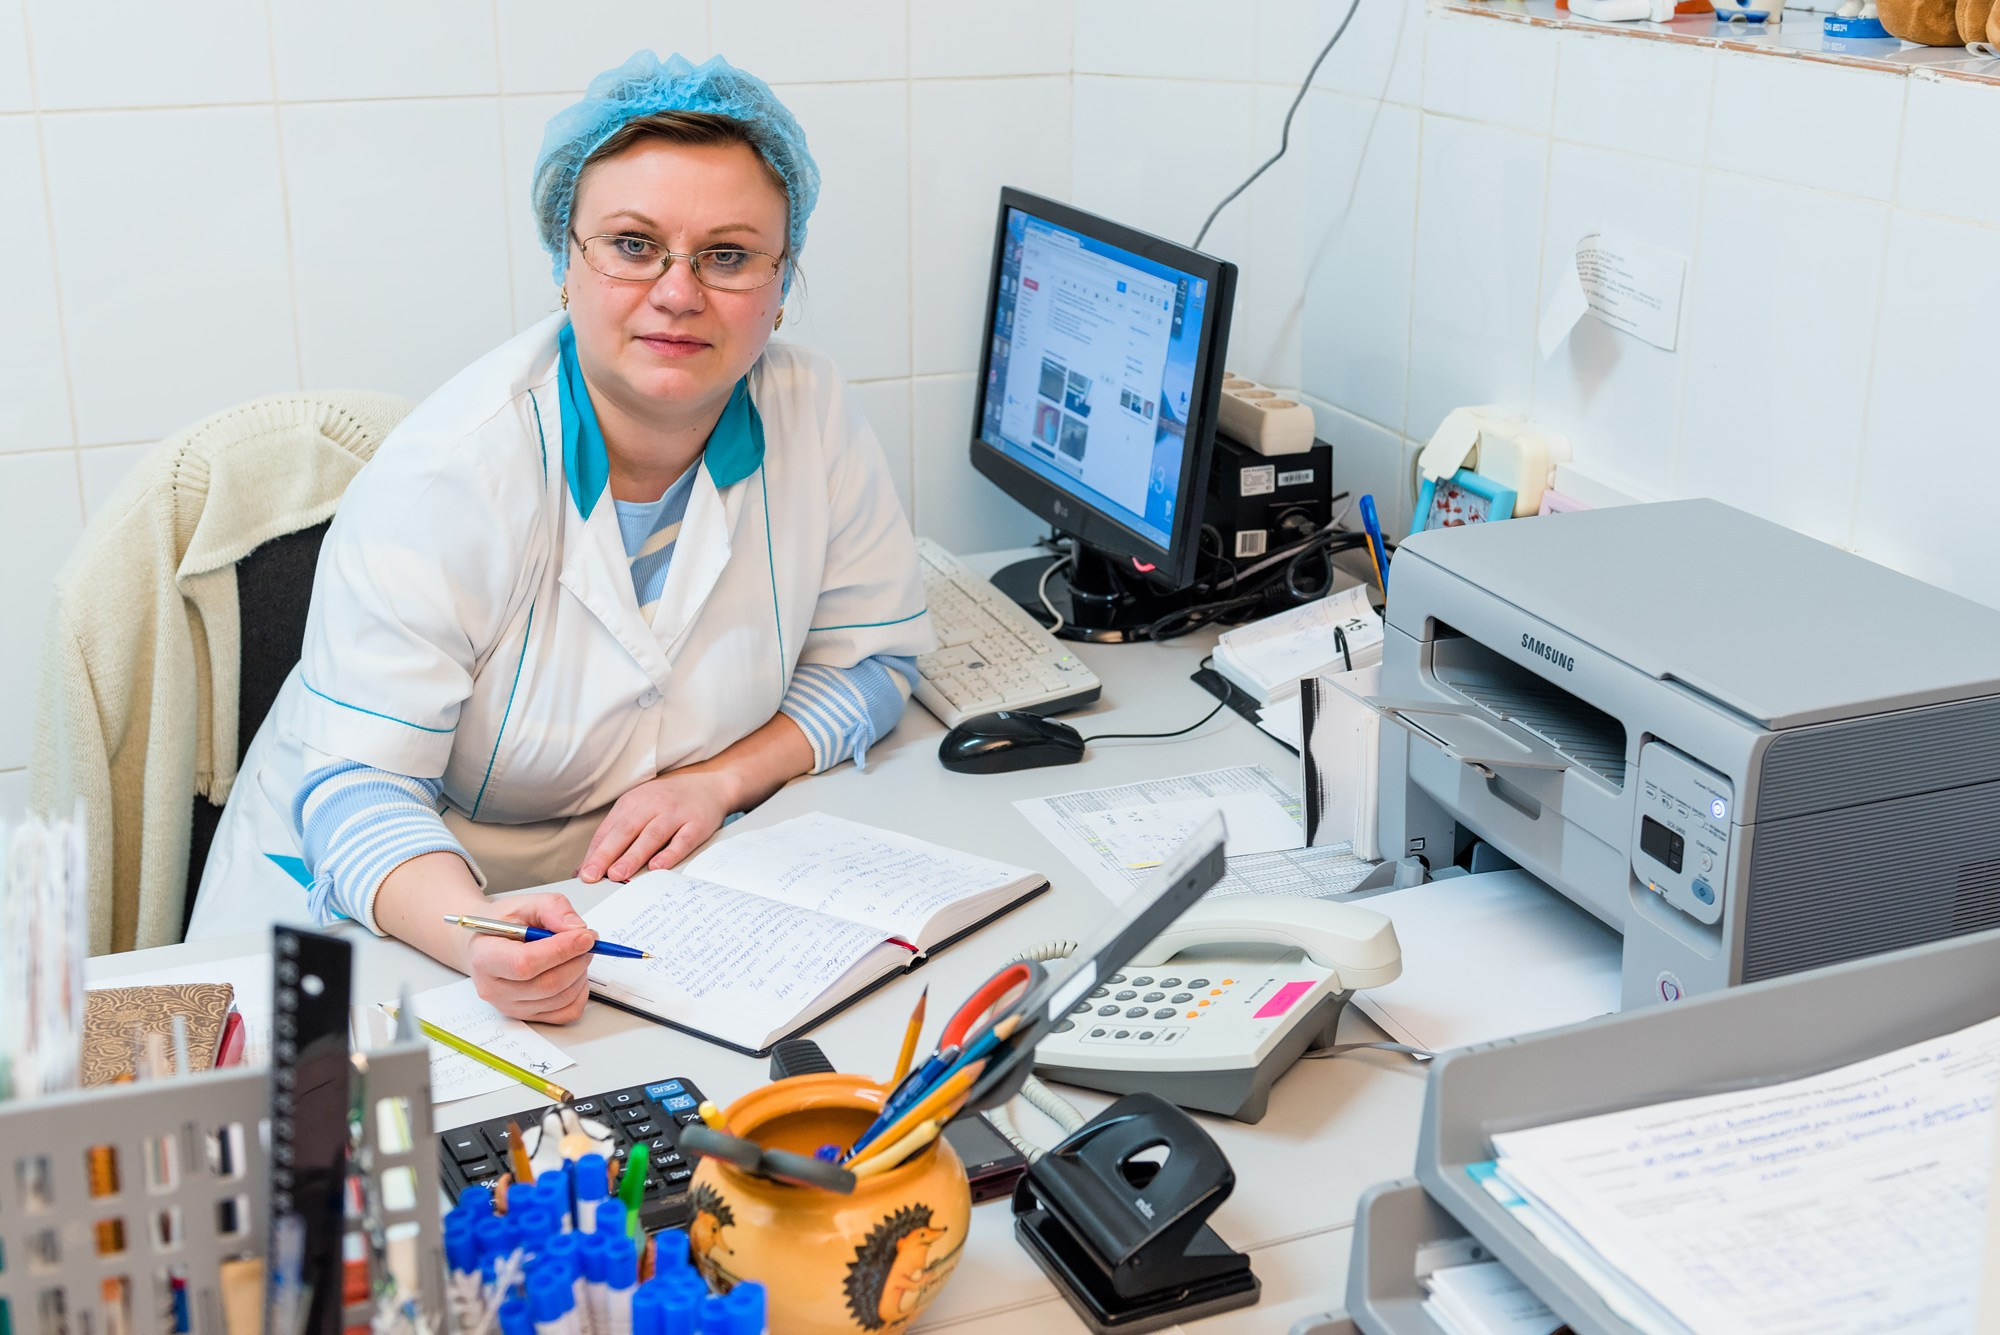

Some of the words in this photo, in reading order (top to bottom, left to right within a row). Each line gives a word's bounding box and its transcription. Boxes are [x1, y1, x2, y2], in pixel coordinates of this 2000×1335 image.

[1521, 633, 1574, 672] SAMSUNG
[652, 1083, 678, 1093] CE/C
[617, 1094, 630, 1102] 0
[575, 1103, 593, 1112] 00
[652, 1140, 663, 1148] 7
[657, 1153, 680, 1164] MR
